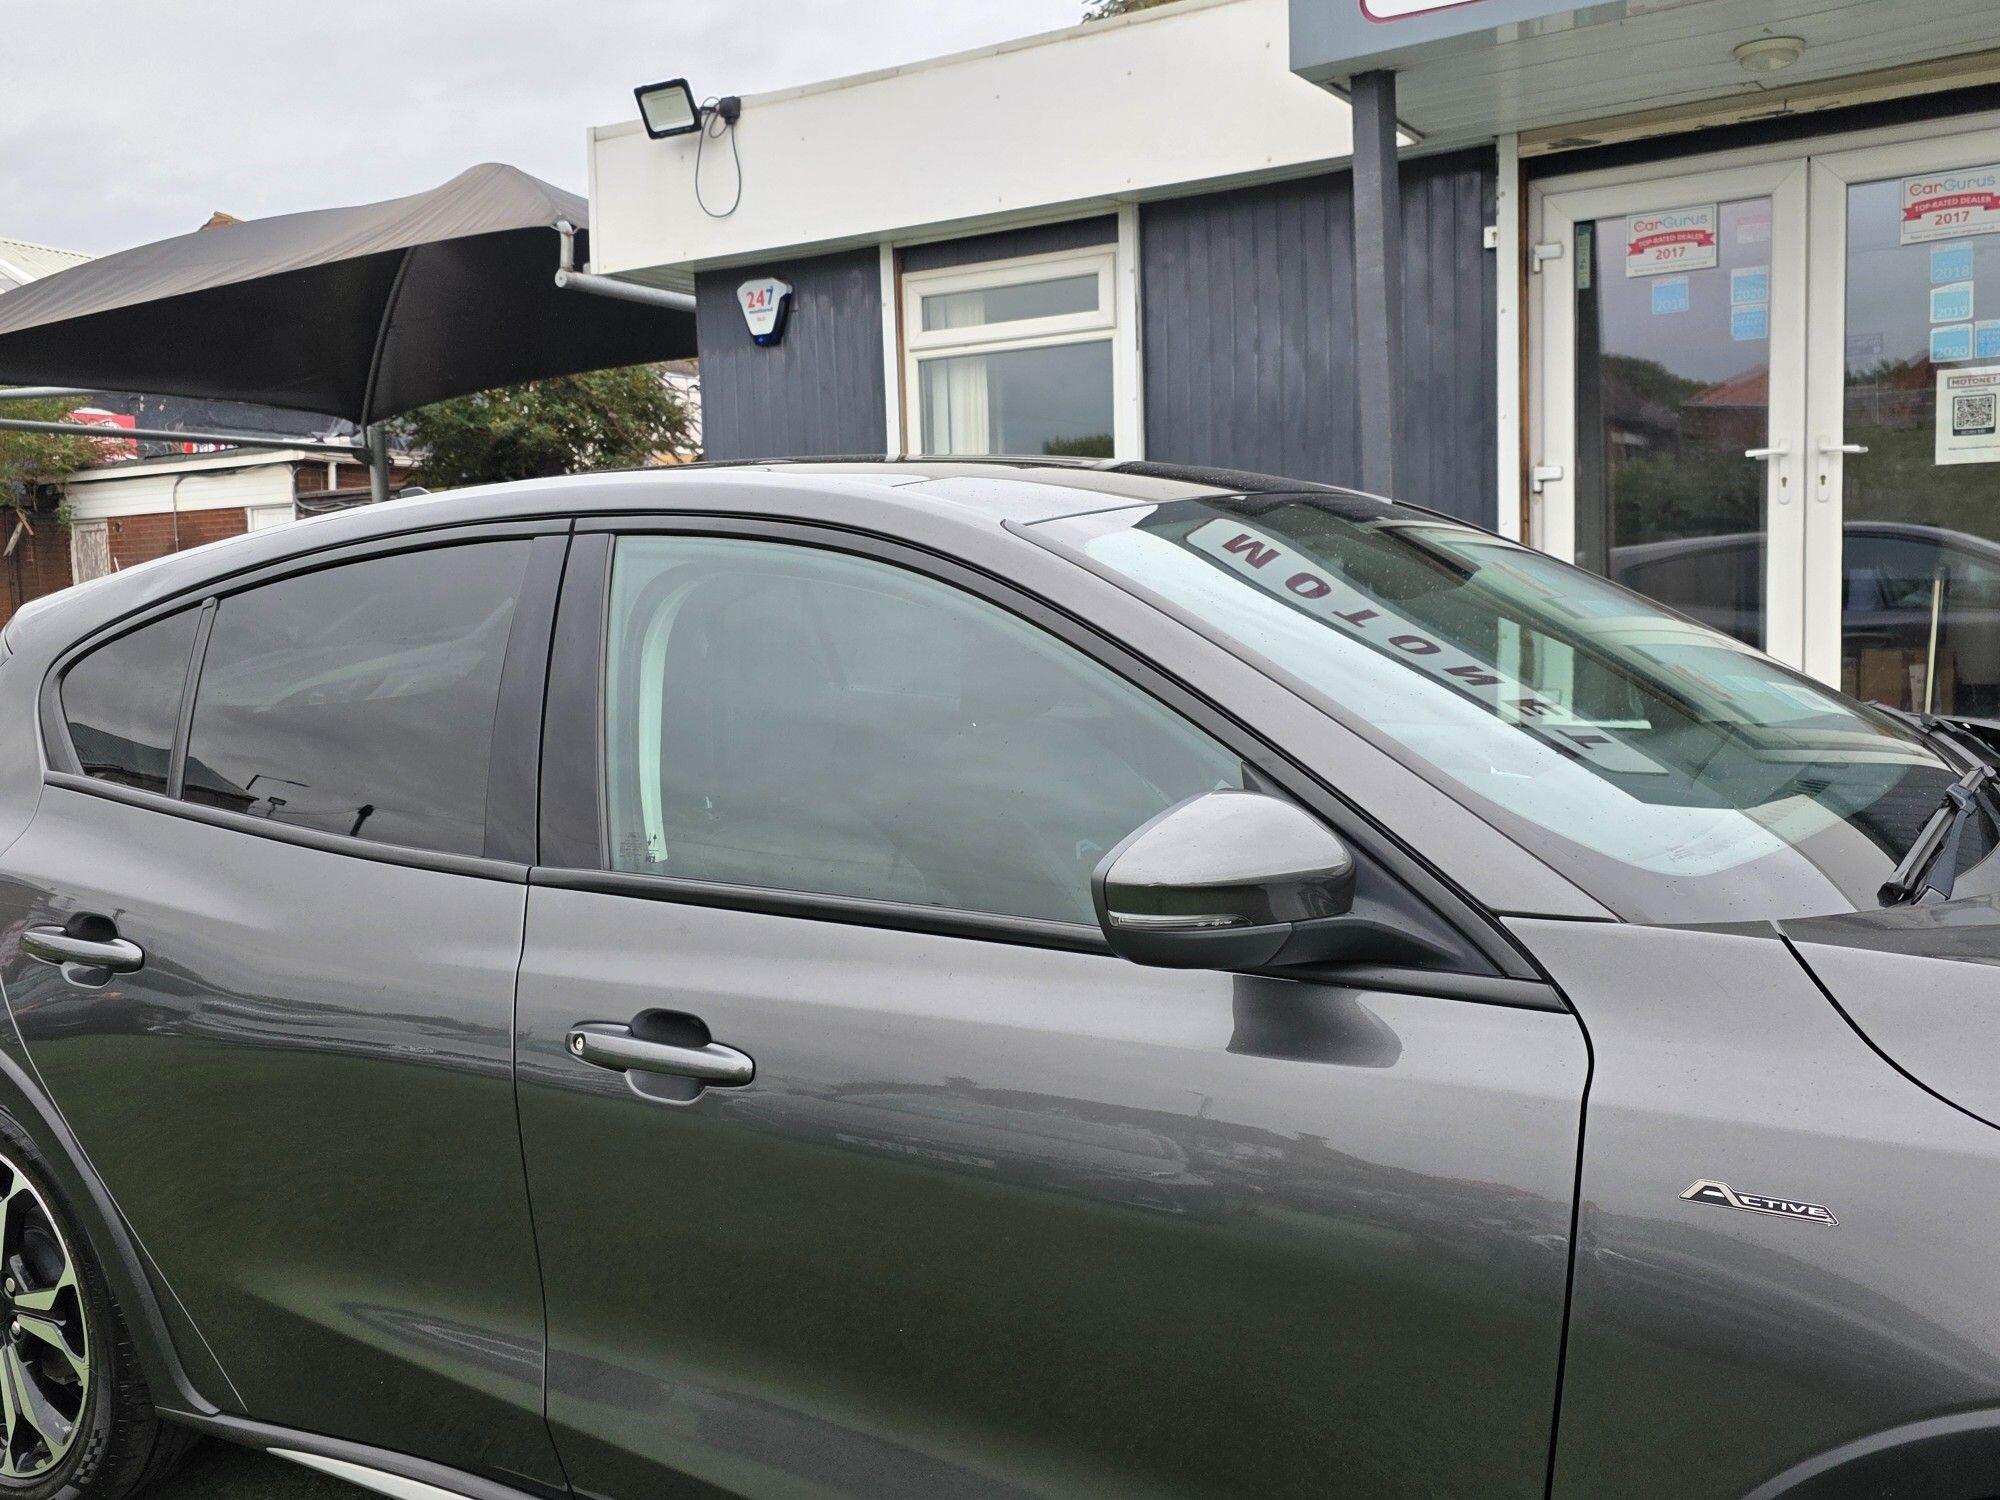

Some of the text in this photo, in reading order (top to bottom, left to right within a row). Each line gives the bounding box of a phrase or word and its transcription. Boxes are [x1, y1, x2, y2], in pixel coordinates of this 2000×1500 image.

[1909, 176, 1996, 196] CarGurus
[1960, 196, 1992, 205] DEALER
[1633, 214, 1708, 233] CarGurus
[1934, 210, 1970, 226] 2017
[1655, 246, 1686, 261] 2017
[746, 285, 774, 308] 247
[1937, 304, 1969, 317] 2019
[1935, 344, 1969, 358] 2020
[1951, 375, 1997, 387] MOTONET
